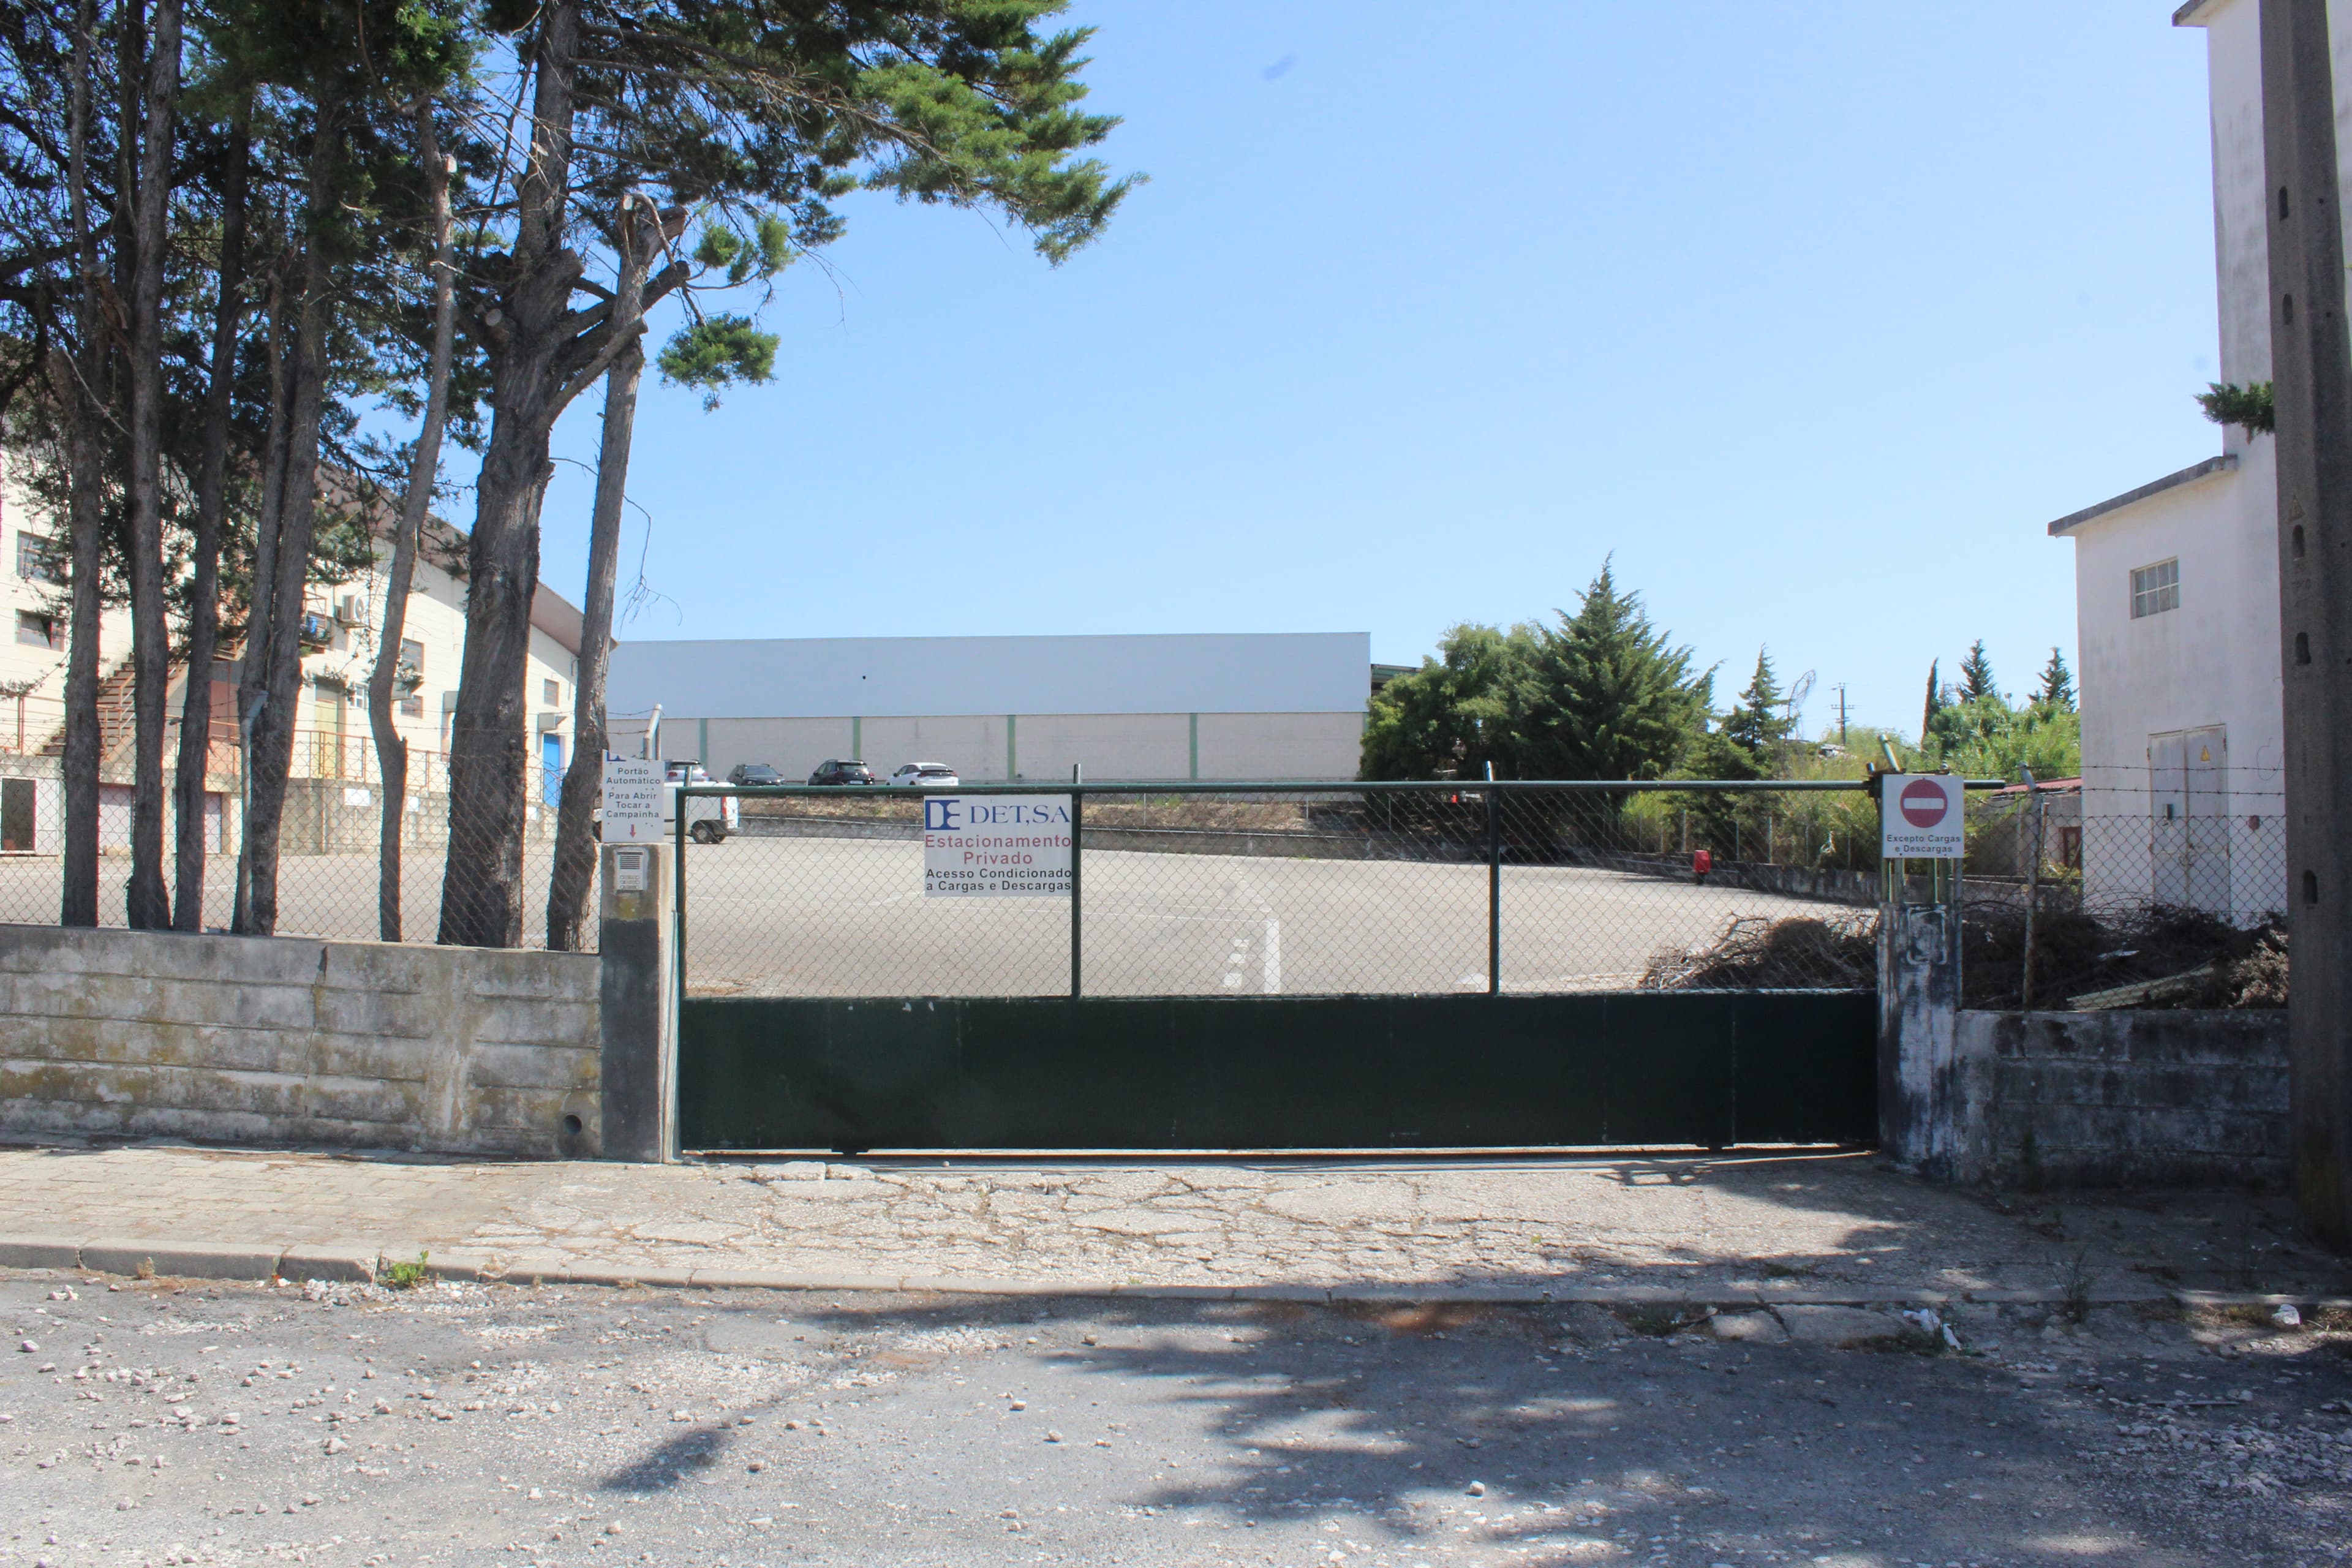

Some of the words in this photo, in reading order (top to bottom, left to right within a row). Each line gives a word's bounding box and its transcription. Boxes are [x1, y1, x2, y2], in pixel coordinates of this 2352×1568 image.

[606, 810, 659, 819] Campainha
[970, 805, 1070, 826] DET,SA
[925, 834, 1071, 848] Estacionamento
[1887, 834, 1924, 843] Excepto
[1928, 834, 1961, 843] Cargas
[1904, 845, 1952, 854] Descargas
[963, 852, 1033, 865] Privado
[926, 869, 974, 878] Acesso
[979, 868, 1072, 878] Condicionado
[938, 881, 984, 892] Cargas
[1002, 881, 1071, 892] Descargas
